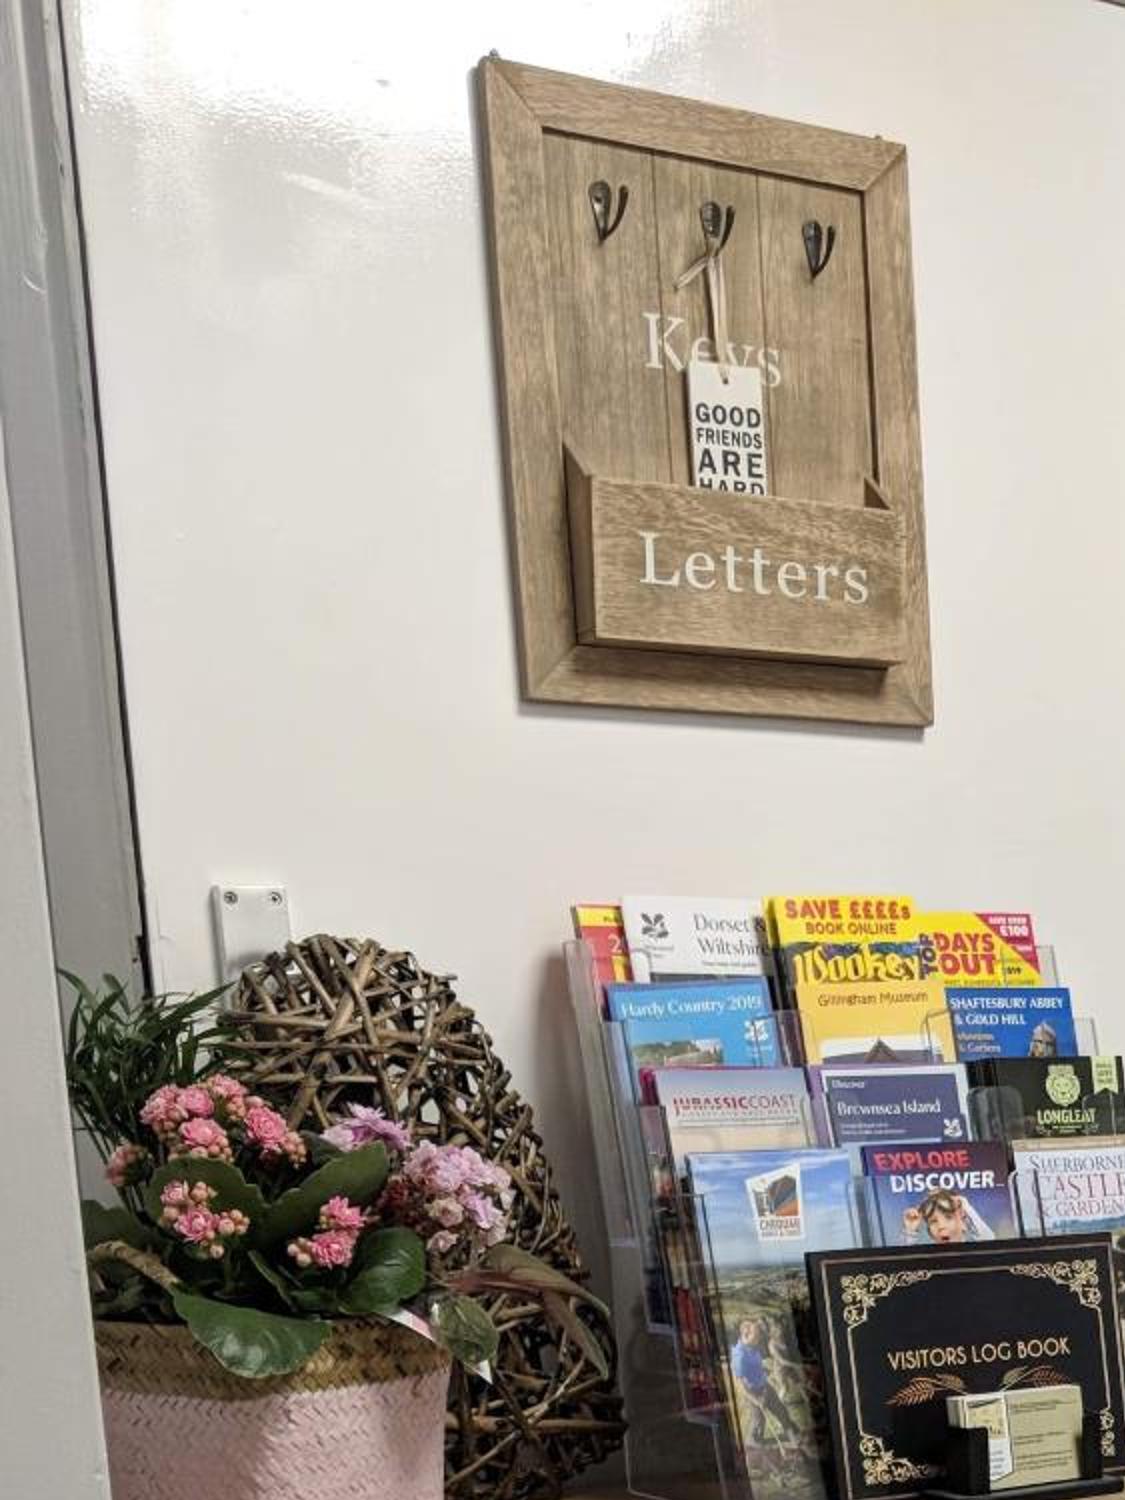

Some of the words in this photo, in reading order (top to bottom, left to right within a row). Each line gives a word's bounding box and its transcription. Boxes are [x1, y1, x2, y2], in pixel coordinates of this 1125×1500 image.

[695, 403, 761, 428] GOOD
[696, 427, 763, 449] FRIENDS
[698, 448, 765, 479] ARE
[639, 531, 869, 604] Letters
[785, 899, 842, 920] SAVE
[693, 912, 750, 933] Dorset
[805, 922, 843, 935] BOOK
[847, 922, 897, 935] ONLINE
[934, 932, 996, 953] DAYS
[919, 934, 938, 980] TOP
[938, 953, 997, 976] OUT
[880, 991, 928, 1003] Museum
[951, 997, 1026, 1009] SHAFTESBURY
[1029, 998, 1063, 1009] ABBEY
[620, 1002, 665, 1020] Hardy
[667, 999, 724, 1016] Country
[965, 1014, 998, 1025] GOLD
[1001, 1014, 1026, 1025] HILL
[837, 1102, 901, 1116] Brownsea
[902, 1098, 941, 1113] Island
[1037, 1108, 1096, 1124] LONGLEAT
[873, 1151, 972, 1171] EXPLORE
[887, 1346, 968, 1370] VISITORS
[971, 1342, 1011, 1363] LOG
[1017, 1336, 1071, 1358] BOOK
